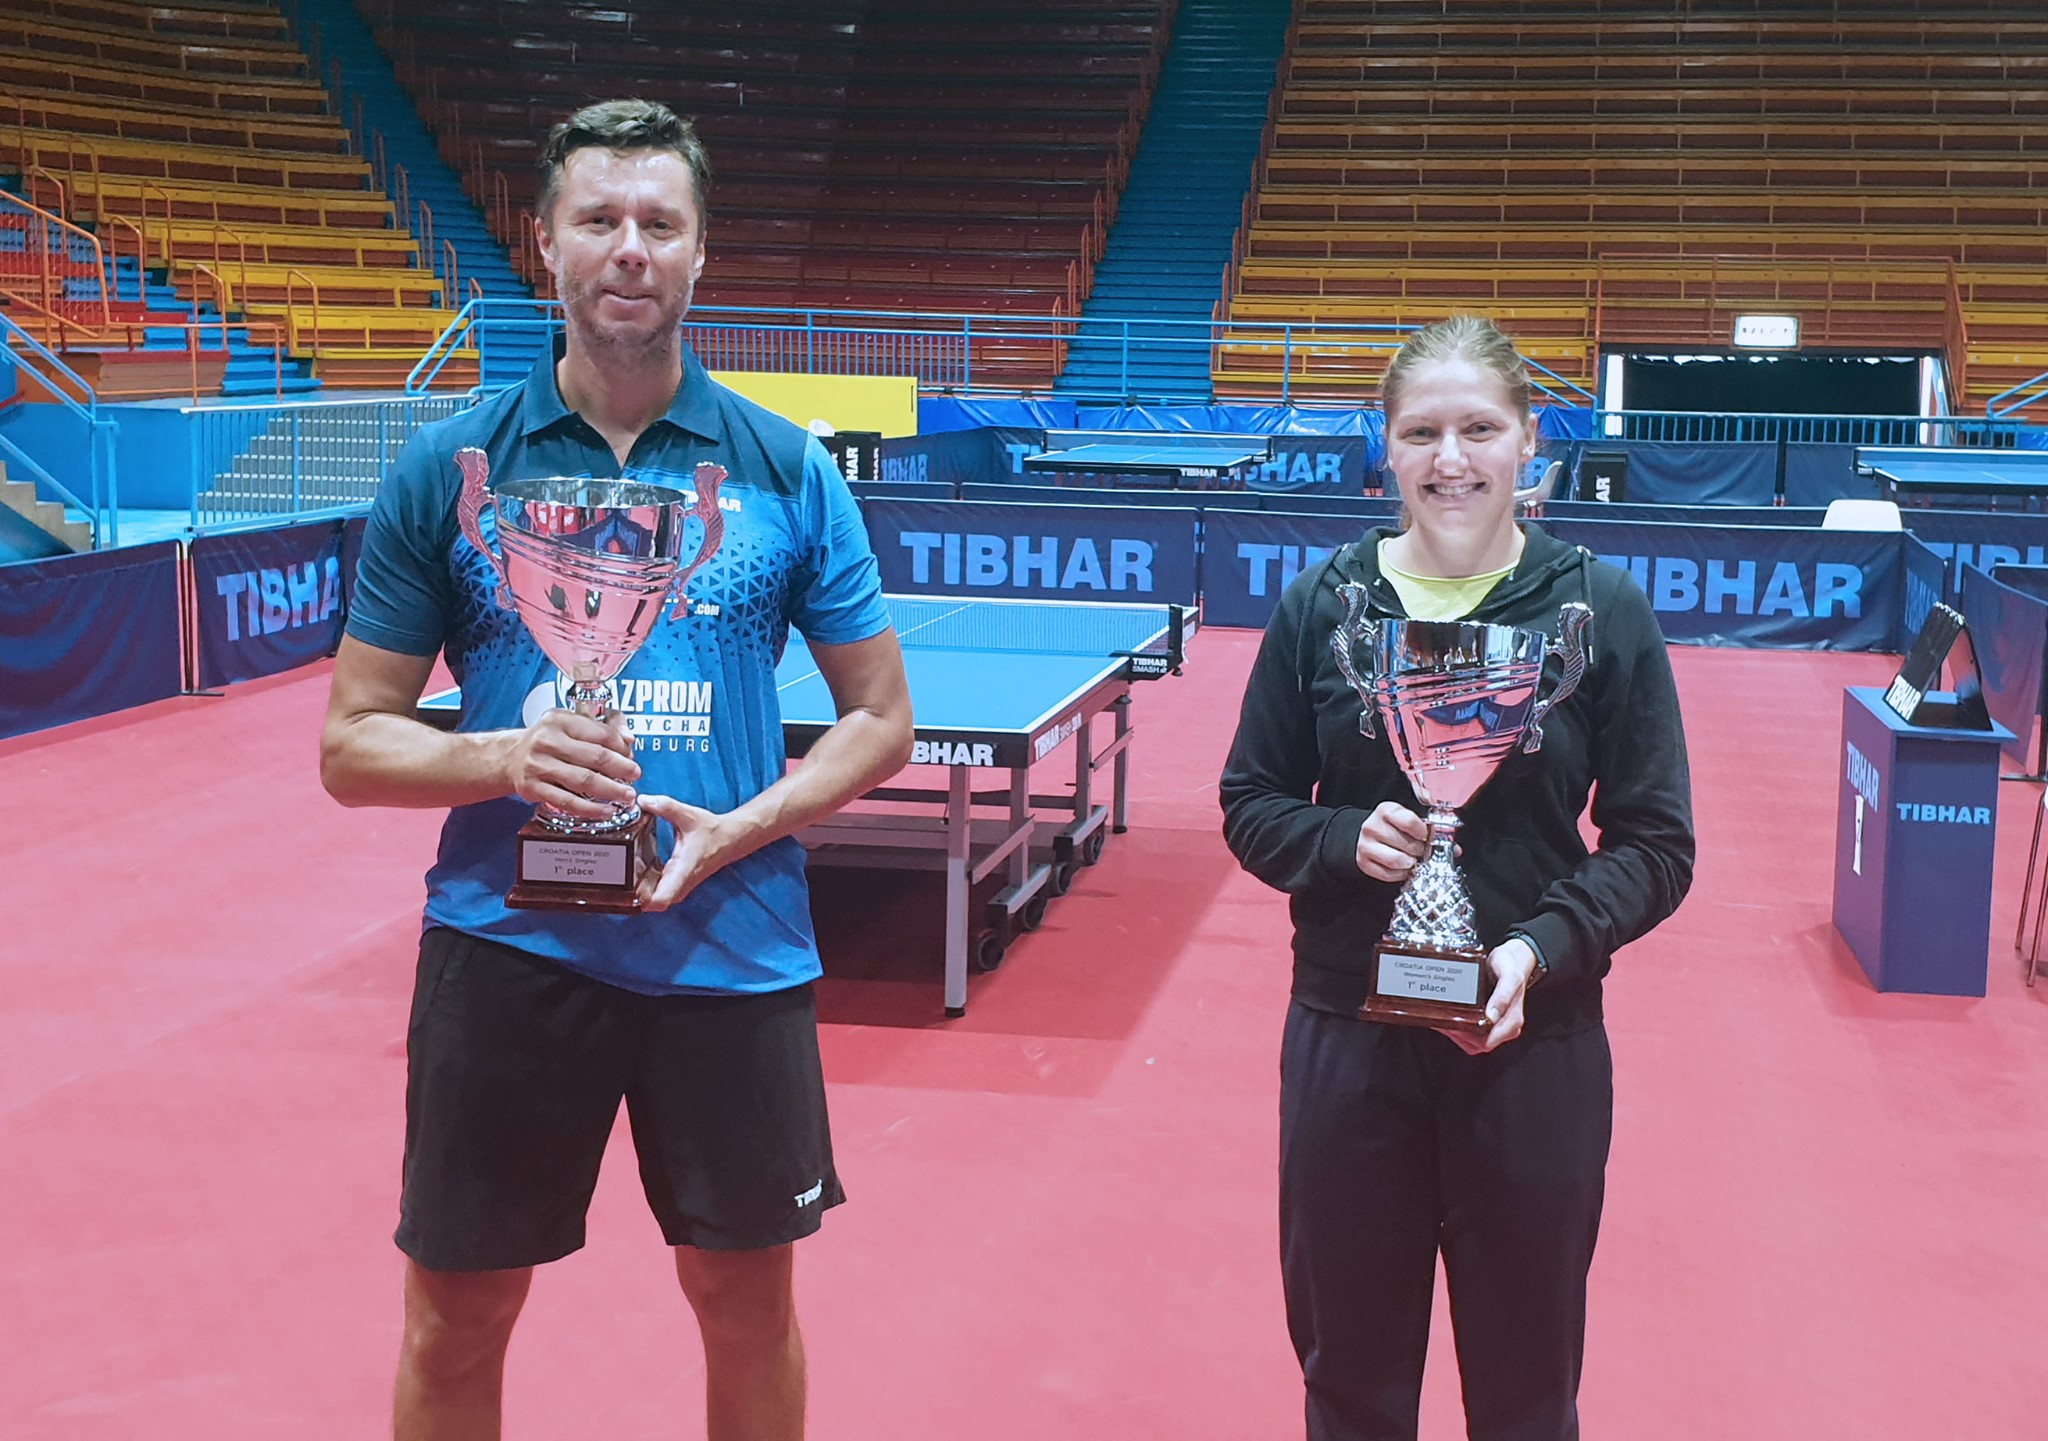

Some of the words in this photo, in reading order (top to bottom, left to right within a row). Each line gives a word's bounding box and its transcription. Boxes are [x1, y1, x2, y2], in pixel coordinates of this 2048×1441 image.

[845, 445, 858, 481] HAR
[881, 453, 928, 482] IBHAR
[1181, 468, 1217, 477] TIBHAR
[900, 531, 1154, 592] TIBHAR
[216, 556, 340, 641] TIBHA
[1132, 657, 1168, 666] TIBHAR
[1886, 674, 1922, 721] TIBHAR
[627, 718, 707, 733] BYCHA
[635, 738, 710, 753] NBURG
[911, 741, 994, 767] BHAR
[1847, 740, 1880, 813] TIBHAR
[1897, 803, 1991, 825] TIBHAR
[539, 848, 570, 856] CROATIA
[572, 849, 592, 857] OPEN
[567, 867, 594, 876] place
[1394, 962, 1423, 970] CROATIA
[1425, 965, 1445, 973] OPEN
[1447, 967, 1463, 975] 2020
[1420, 982, 1447, 993] place
